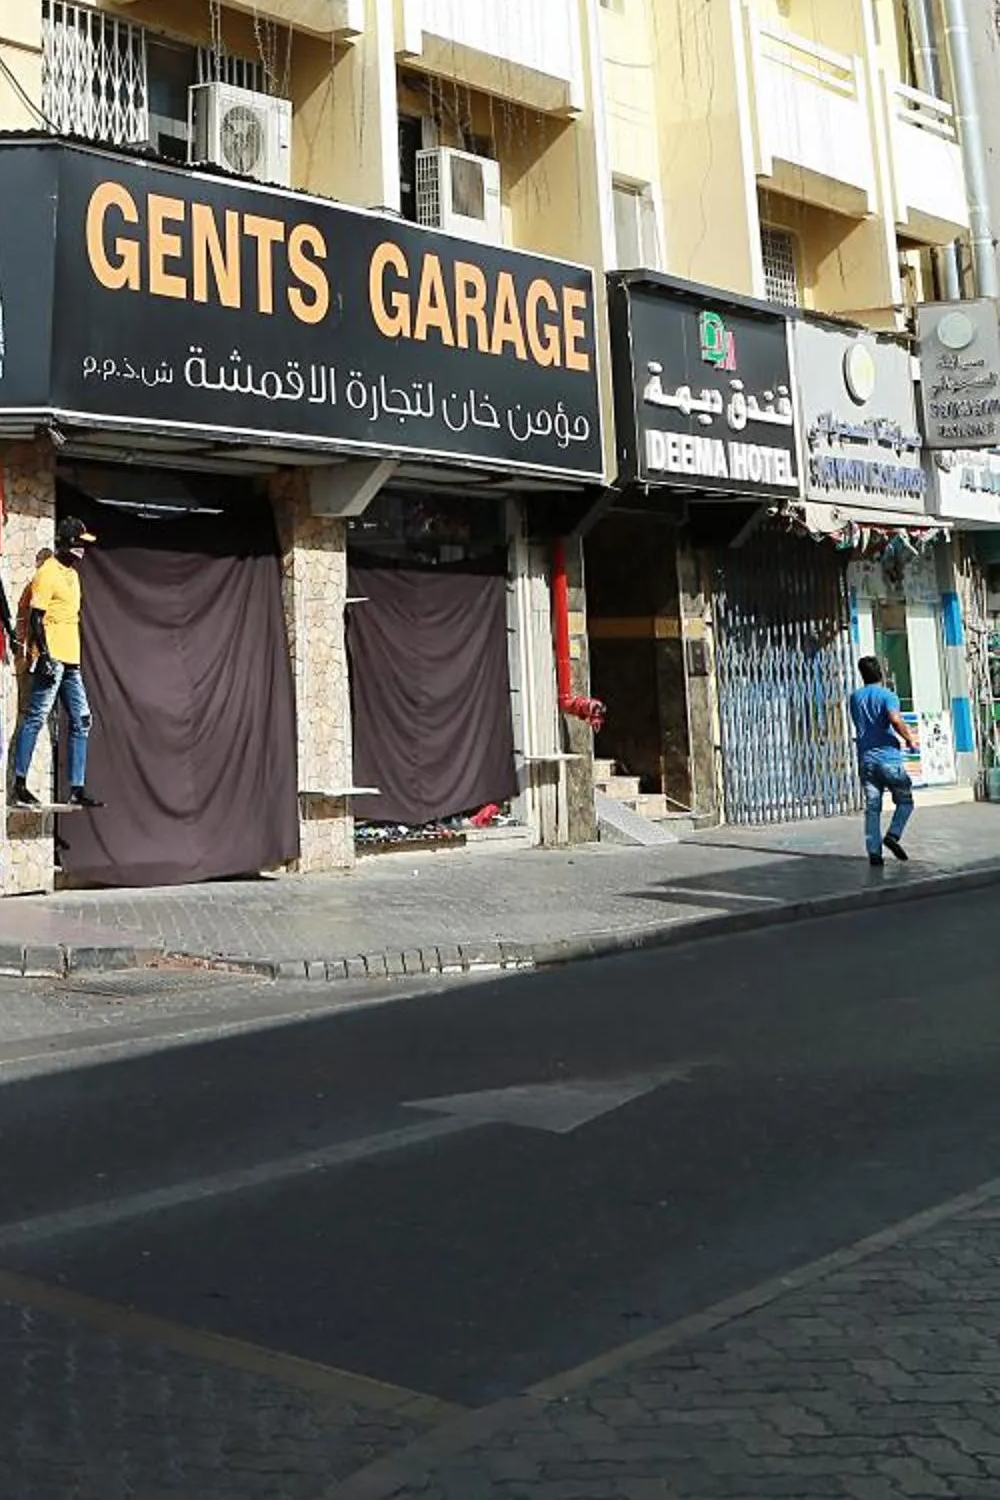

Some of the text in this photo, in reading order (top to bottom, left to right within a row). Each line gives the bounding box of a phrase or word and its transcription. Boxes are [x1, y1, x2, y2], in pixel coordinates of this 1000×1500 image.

[85, 181, 591, 372] GENTS GARAGE
[185, 346, 336, 404] الاقمشة
[346, 370, 435, 423] لتجارة
[644, 361, 793, 430] فندق ديمة
[442, 389, 501, 431] خان
[645, 429, 799, 487] DEEMA HOTEL
